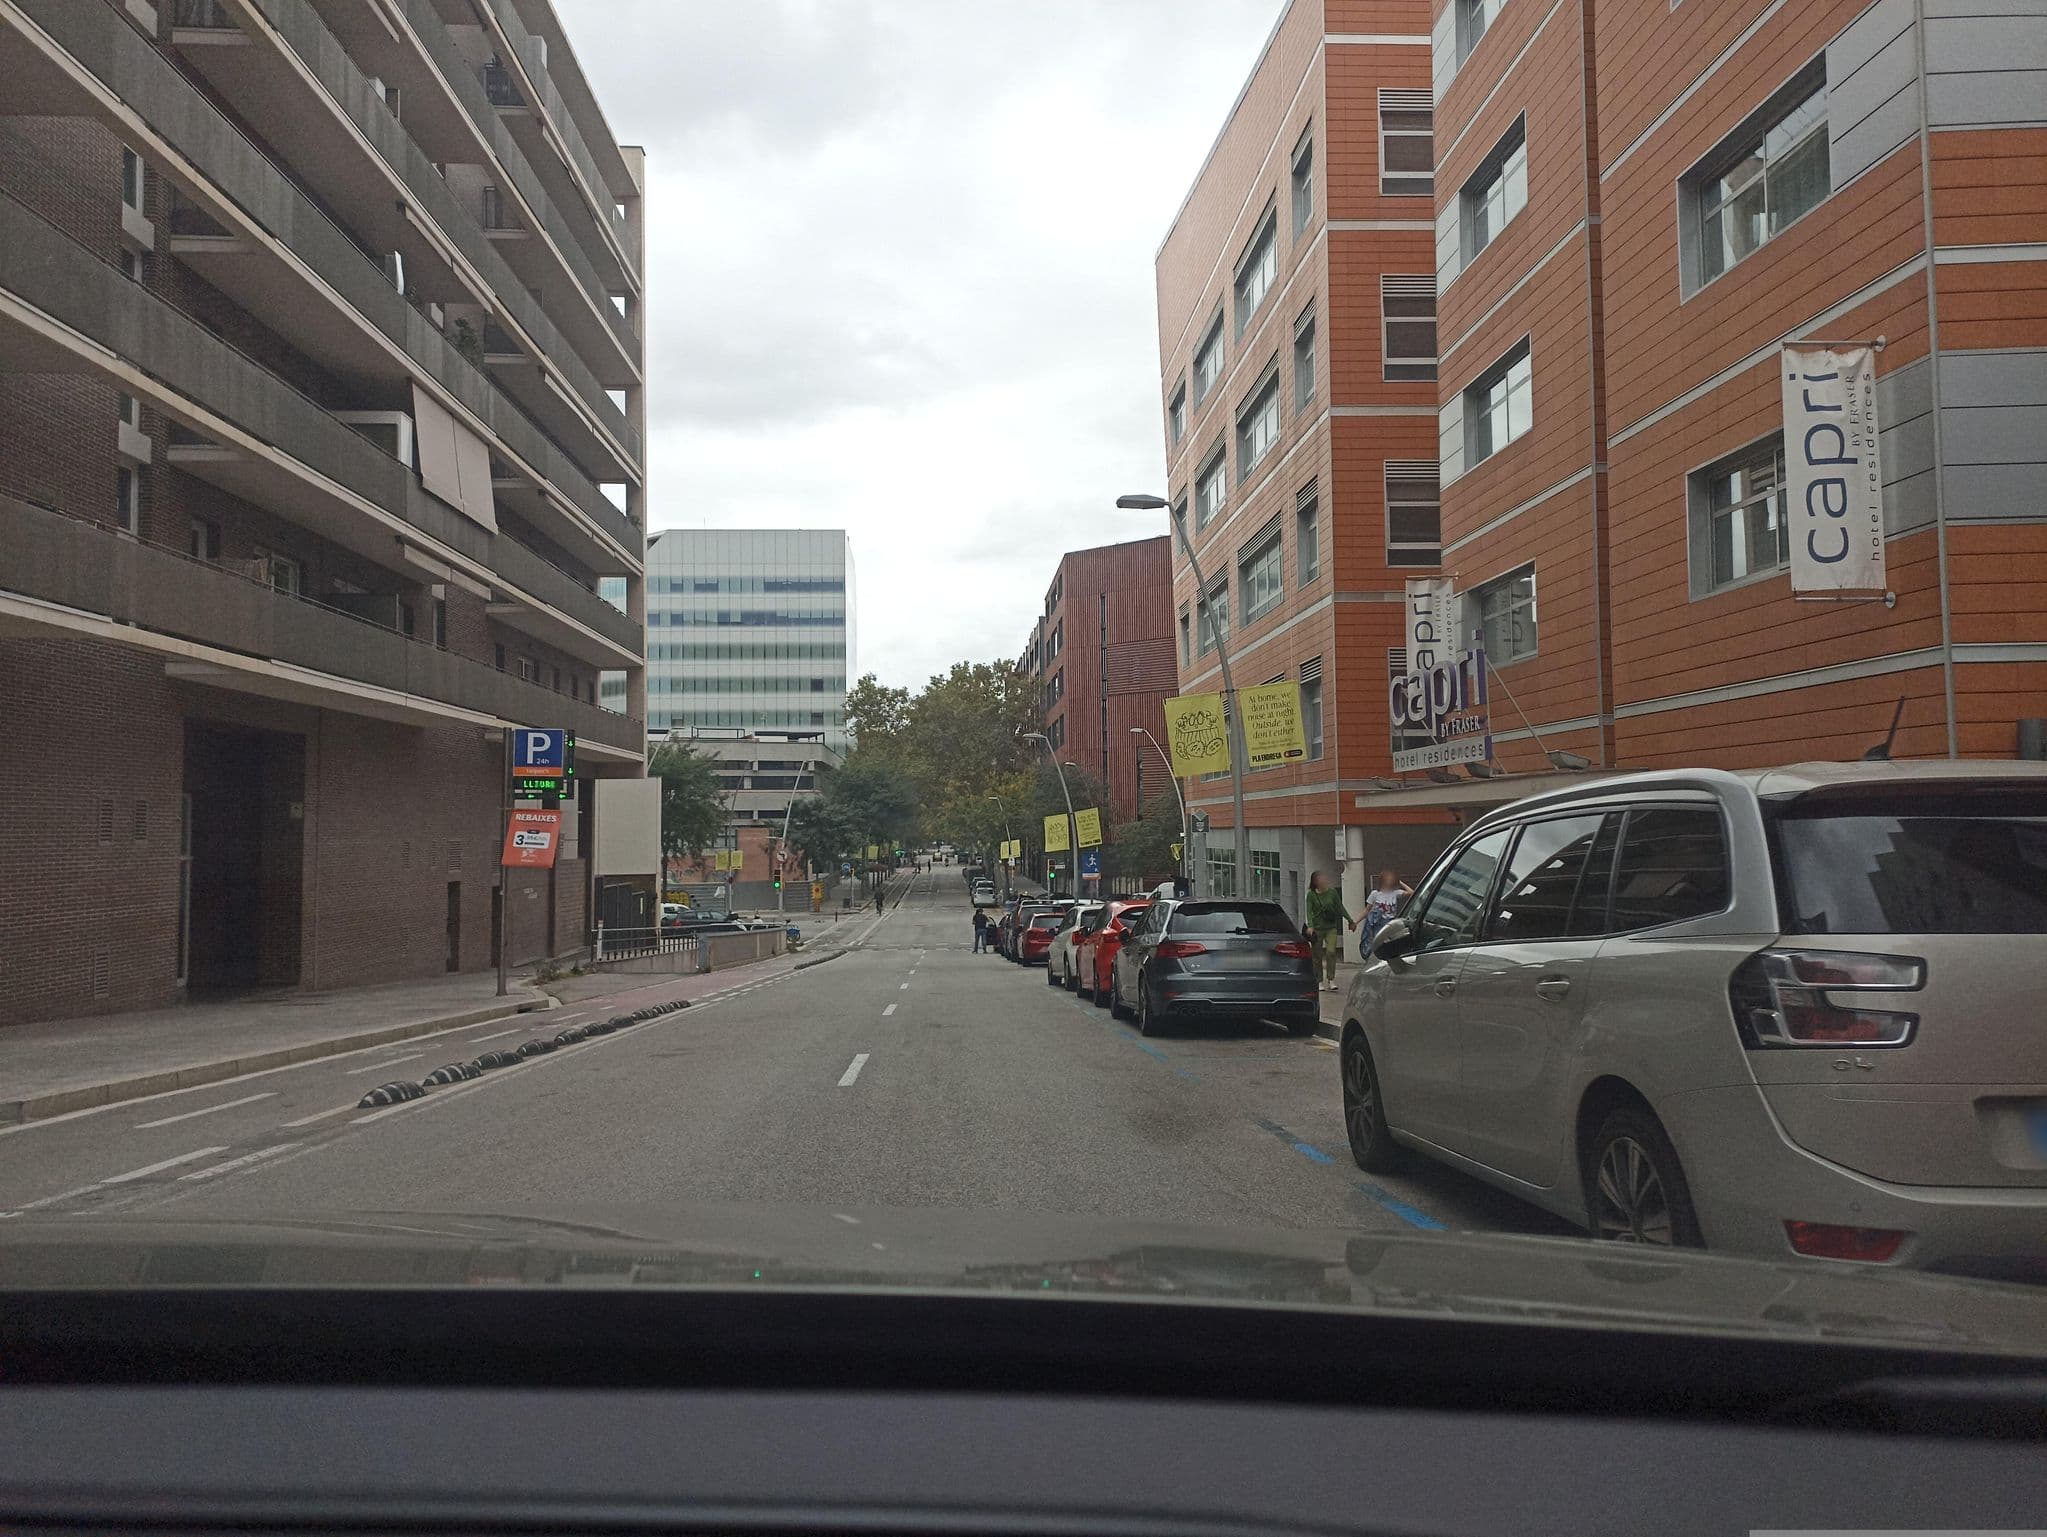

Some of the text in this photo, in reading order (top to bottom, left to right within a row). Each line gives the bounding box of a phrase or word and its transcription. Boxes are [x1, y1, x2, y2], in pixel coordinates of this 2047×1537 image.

[1845, 375, 1861, 447] BY FRASER
[1789, 372, 1858, 564] capri
[1862, 372, 1881, 562] hotel residences
[1408, 593, 1442, 670] apri
[1390, 629, 1487, 737] capri
[527, 732, 551, 764] P
[1440, 715, 1481, 737] BY FRASER
[1394, 742, 1484, 769] hotel residences
[515, 813, 557, 822] REBAIXES
[515, 834, 525, 845] 3
